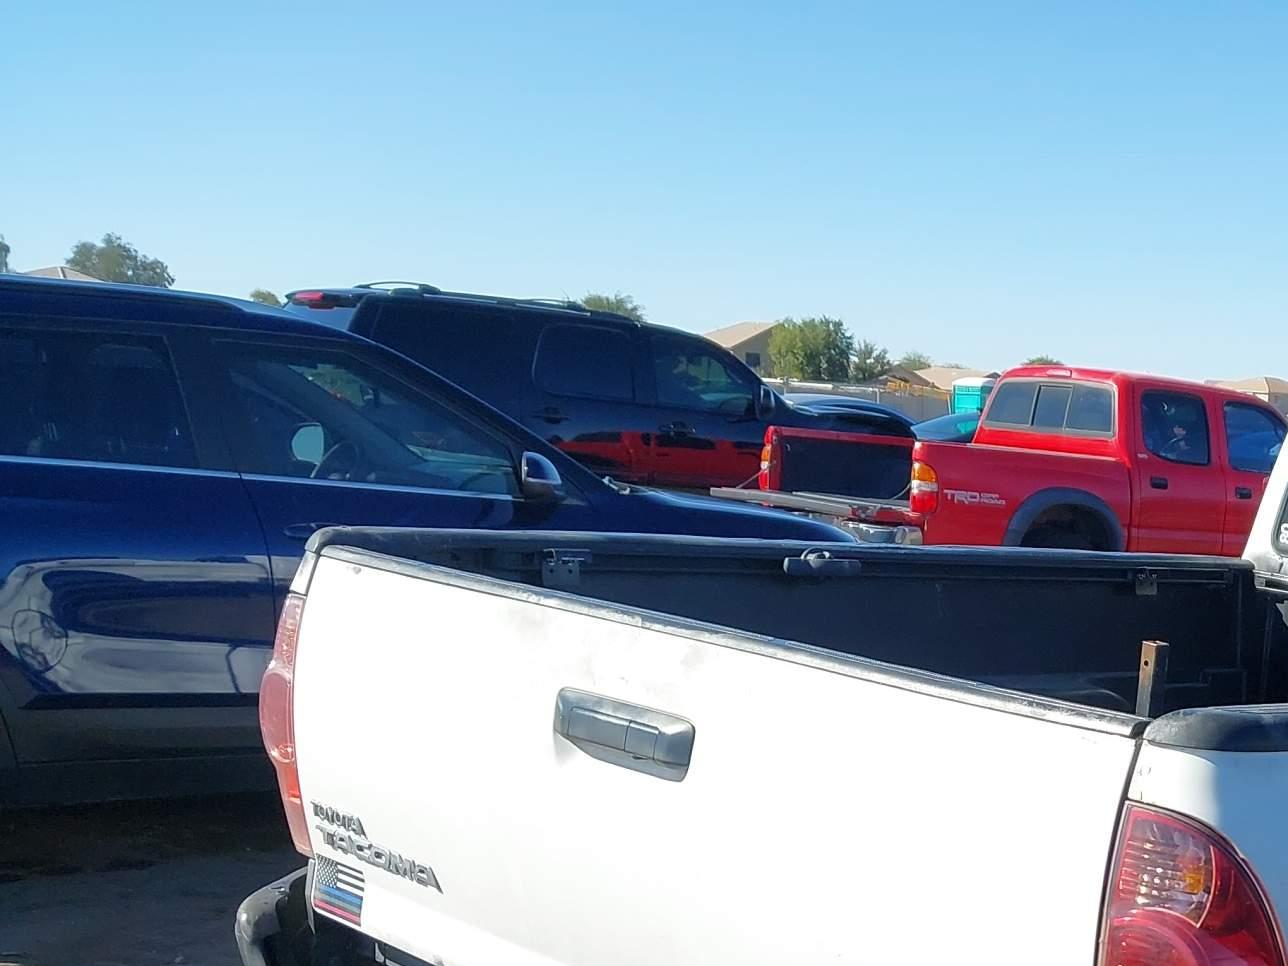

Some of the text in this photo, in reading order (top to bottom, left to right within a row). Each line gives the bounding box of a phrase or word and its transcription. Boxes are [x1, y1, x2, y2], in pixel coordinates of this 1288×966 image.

[943, 489, 980, 505] TRD
[310, 799, 368, 840] TOYOTA
[315, 824, 443, 894] TACOMA
